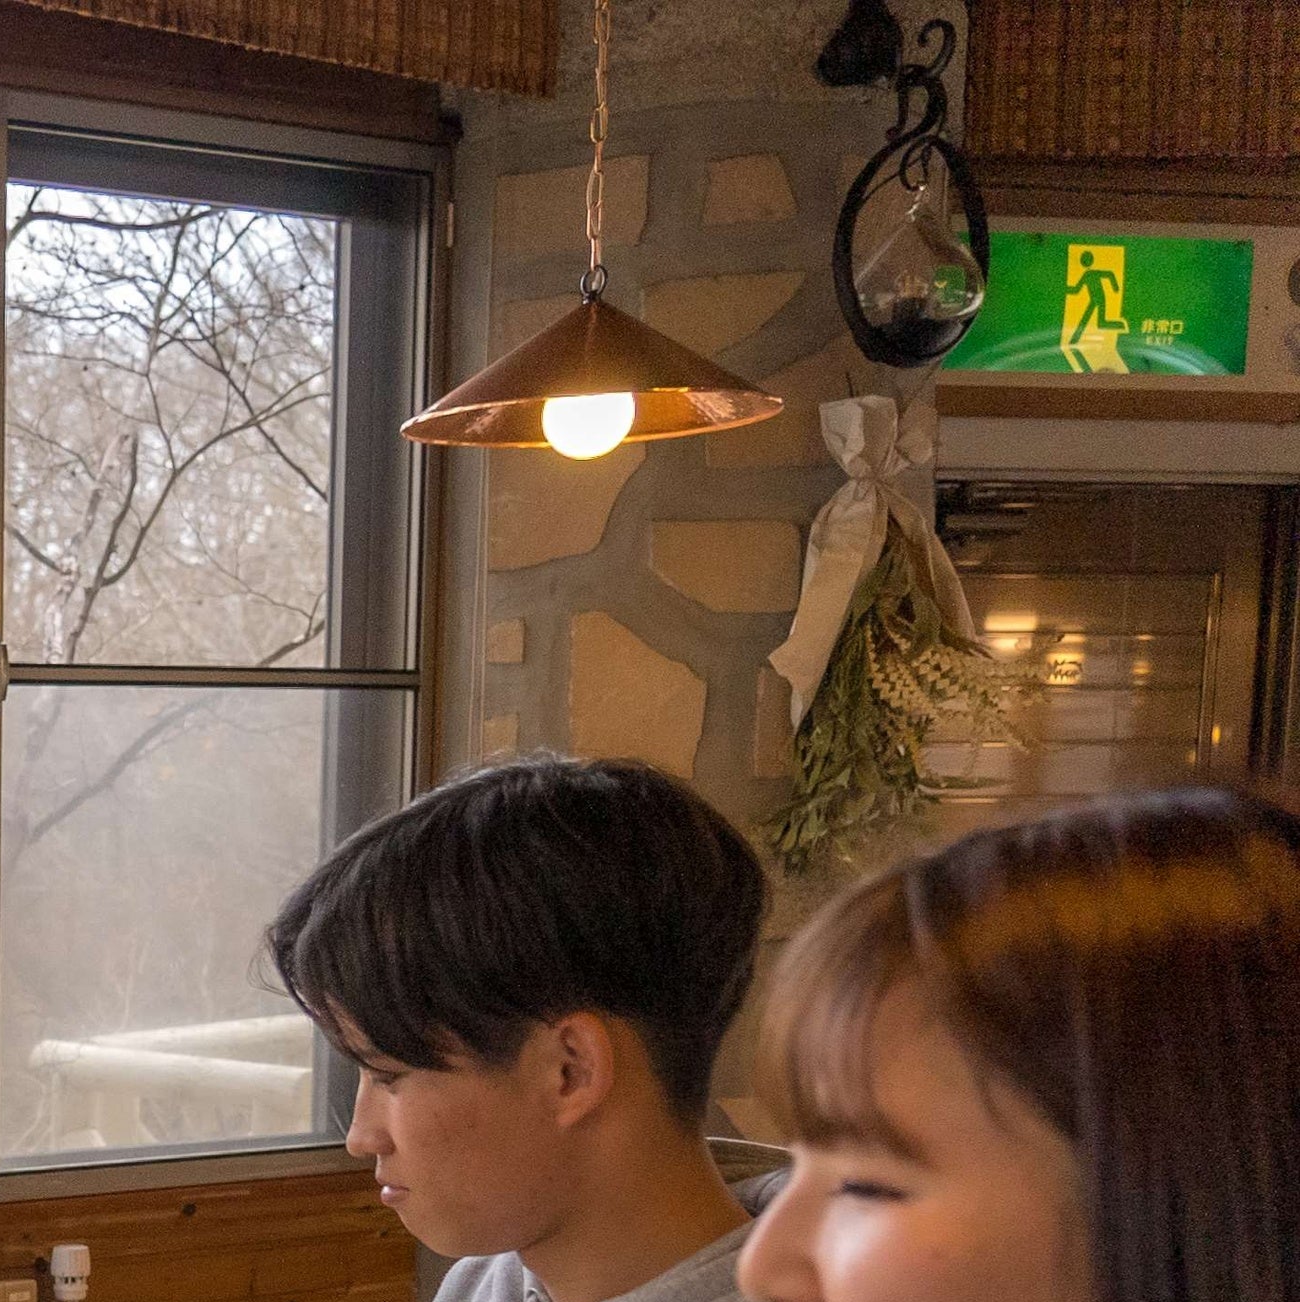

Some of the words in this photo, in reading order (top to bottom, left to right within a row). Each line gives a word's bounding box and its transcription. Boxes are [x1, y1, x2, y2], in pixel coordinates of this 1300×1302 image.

[1142, 319, 1183, 334] 非常口
[1146, 336, 1174, 346] EXIT
